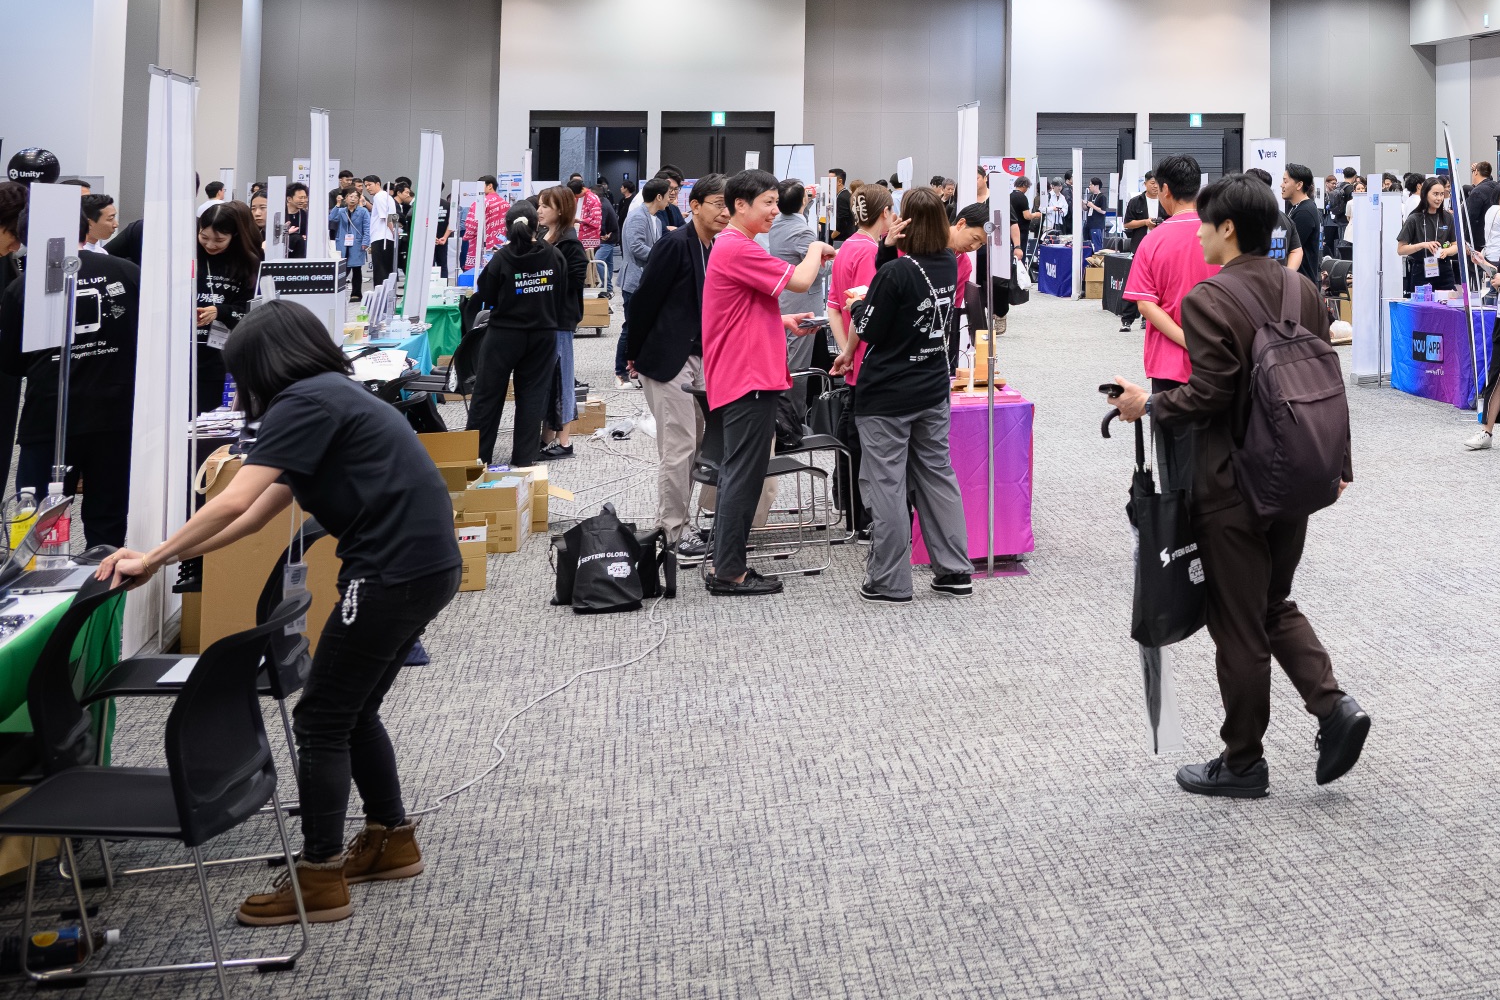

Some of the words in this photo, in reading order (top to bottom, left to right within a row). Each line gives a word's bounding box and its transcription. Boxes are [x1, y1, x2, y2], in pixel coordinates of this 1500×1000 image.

[19, 170, 42, 179] Unity
[90, 276, 107, 284] UP!
[515, 278, 541, 288] MAGIC
[1413, 339, 1426, 353] YOU
[1428, 341, 1441, 355] APP
[70, 350, 97, 360] Payment
[97, 346, 119, 356] Service
[581, 552, 606, 564] SEPTENI
